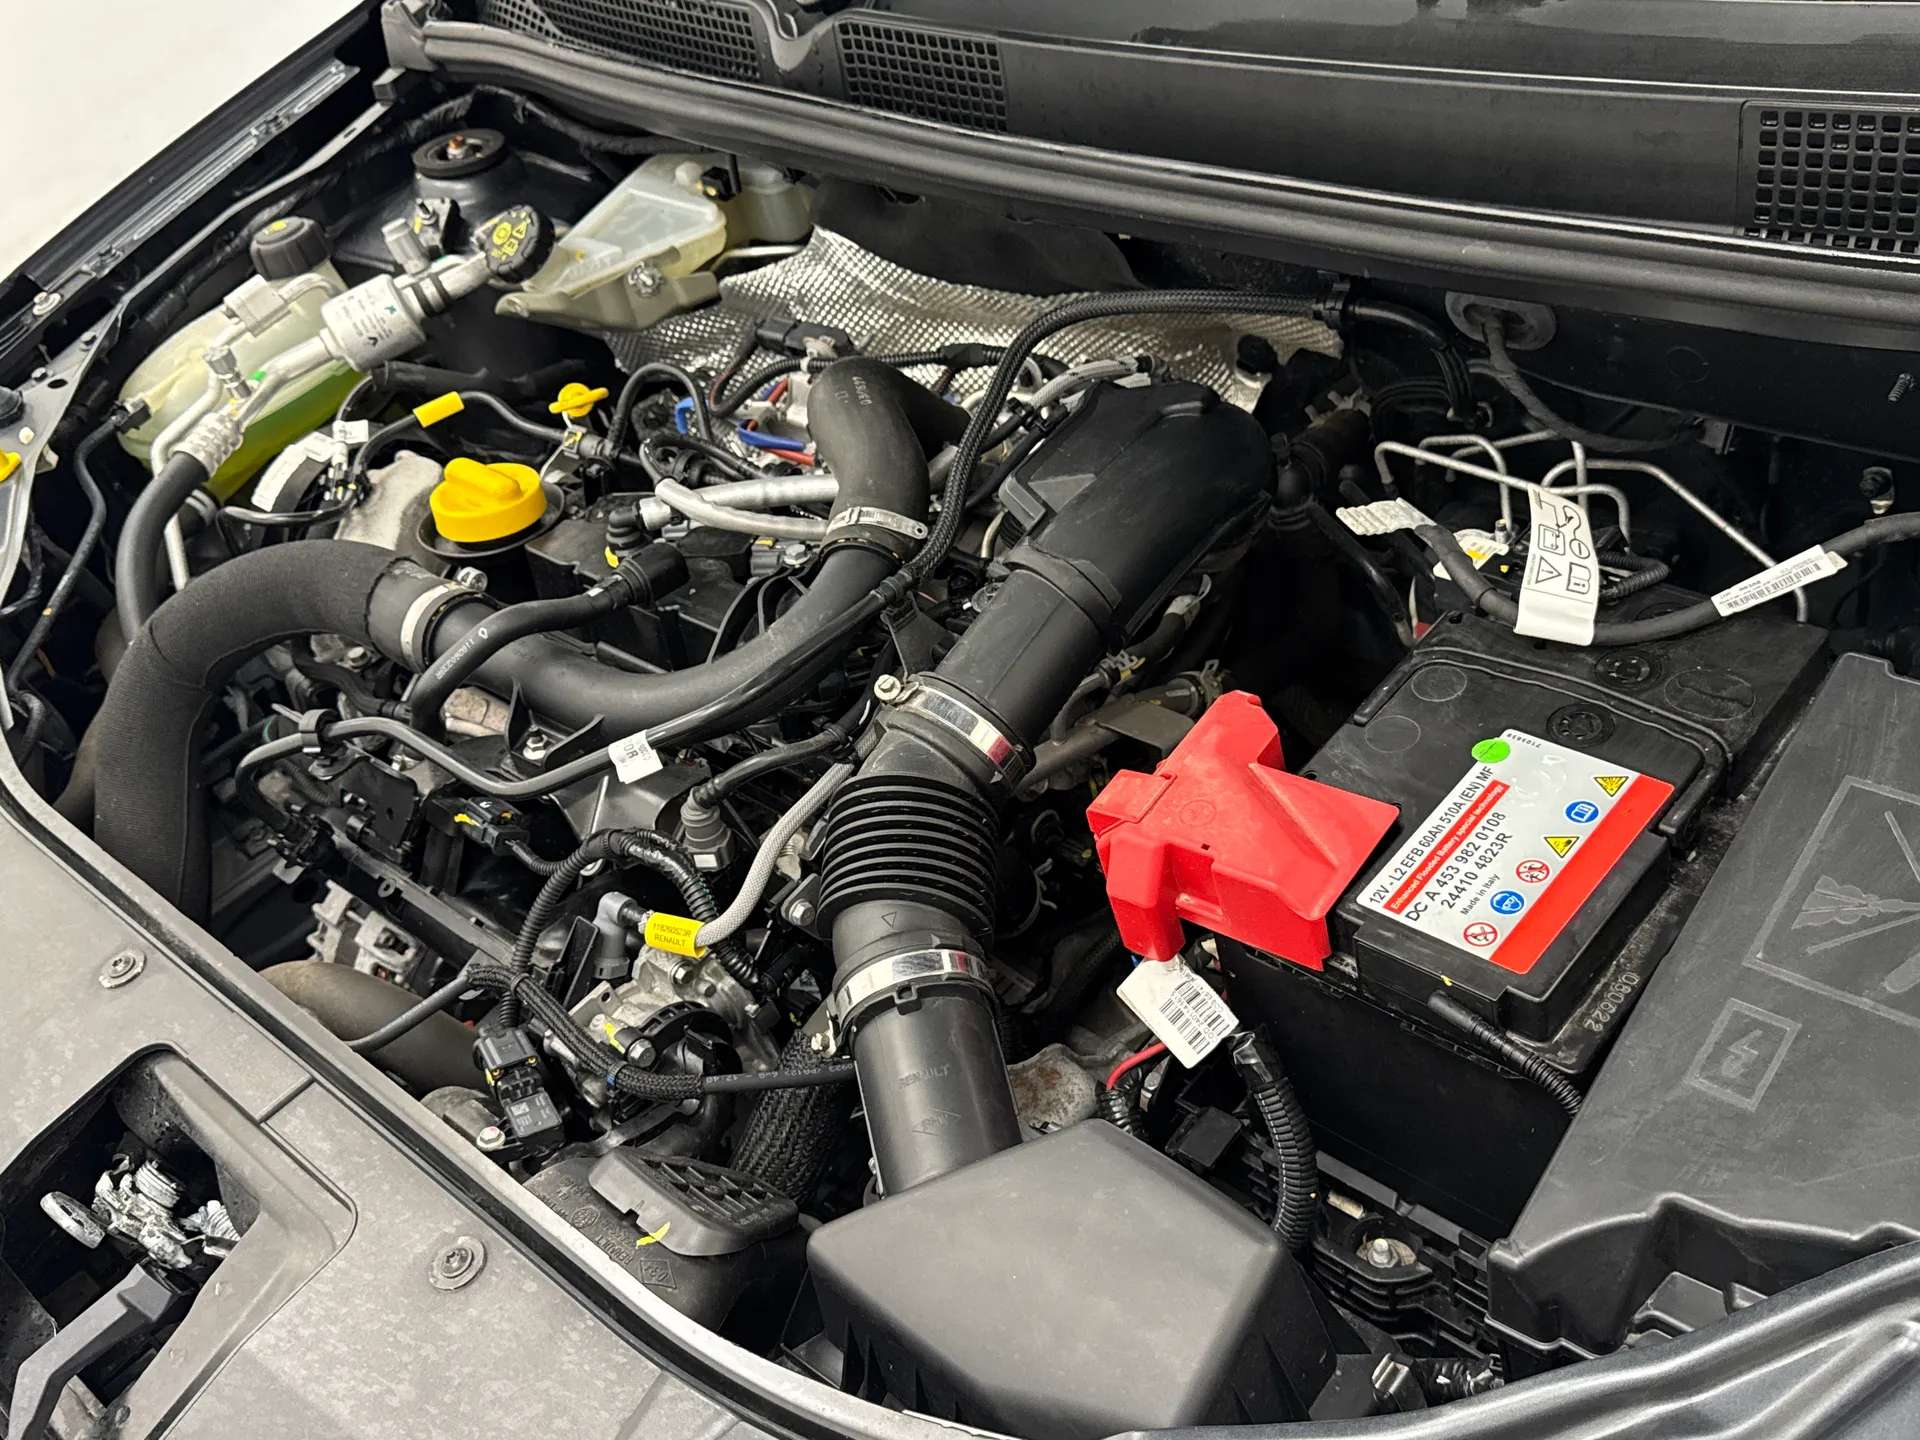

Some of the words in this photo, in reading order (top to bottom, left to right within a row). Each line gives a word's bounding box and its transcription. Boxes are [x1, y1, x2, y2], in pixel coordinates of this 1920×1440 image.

[1369, 884, 1390, 903] 12V
[1389, 867, 1408, 881] L2
[1400, 847, 1425, 869] EFB
[1418, 824, 1446, 848] 60Ah
[1439, 802, 1466, 824] 510A
[1459, 781, 1485, 802] (EN)
[1475, 766, 1493, 782] MF
[1389, 878, 1422, 910] Enhanced
[1415, 854, 1442, 881] Flooded
[1435, 836, 1461, 858] Battery
[1455, 814, 1478, 837] special
[1471, 784, 1505, 817] technology
[1405, 901, 1428, 922] DC
[1425, 891, 1441, 902] A
[1435, 865, 1460, 888] 453
[1454, 841, 1481, 864] 982
[1475, 812, 1506, 841] 0108
[1440, 871, 1479, 909] 24410
[1474, 832, 1512, 870] 4823R
[1460, 896, 1480, 915] Made
[1477, 889, 1487, 897] in
[1482, 873, 1501, 889] Italy
[654, 933, 687, 947] RENAULT
[596, 1234, 634, 1266] RENAULT
